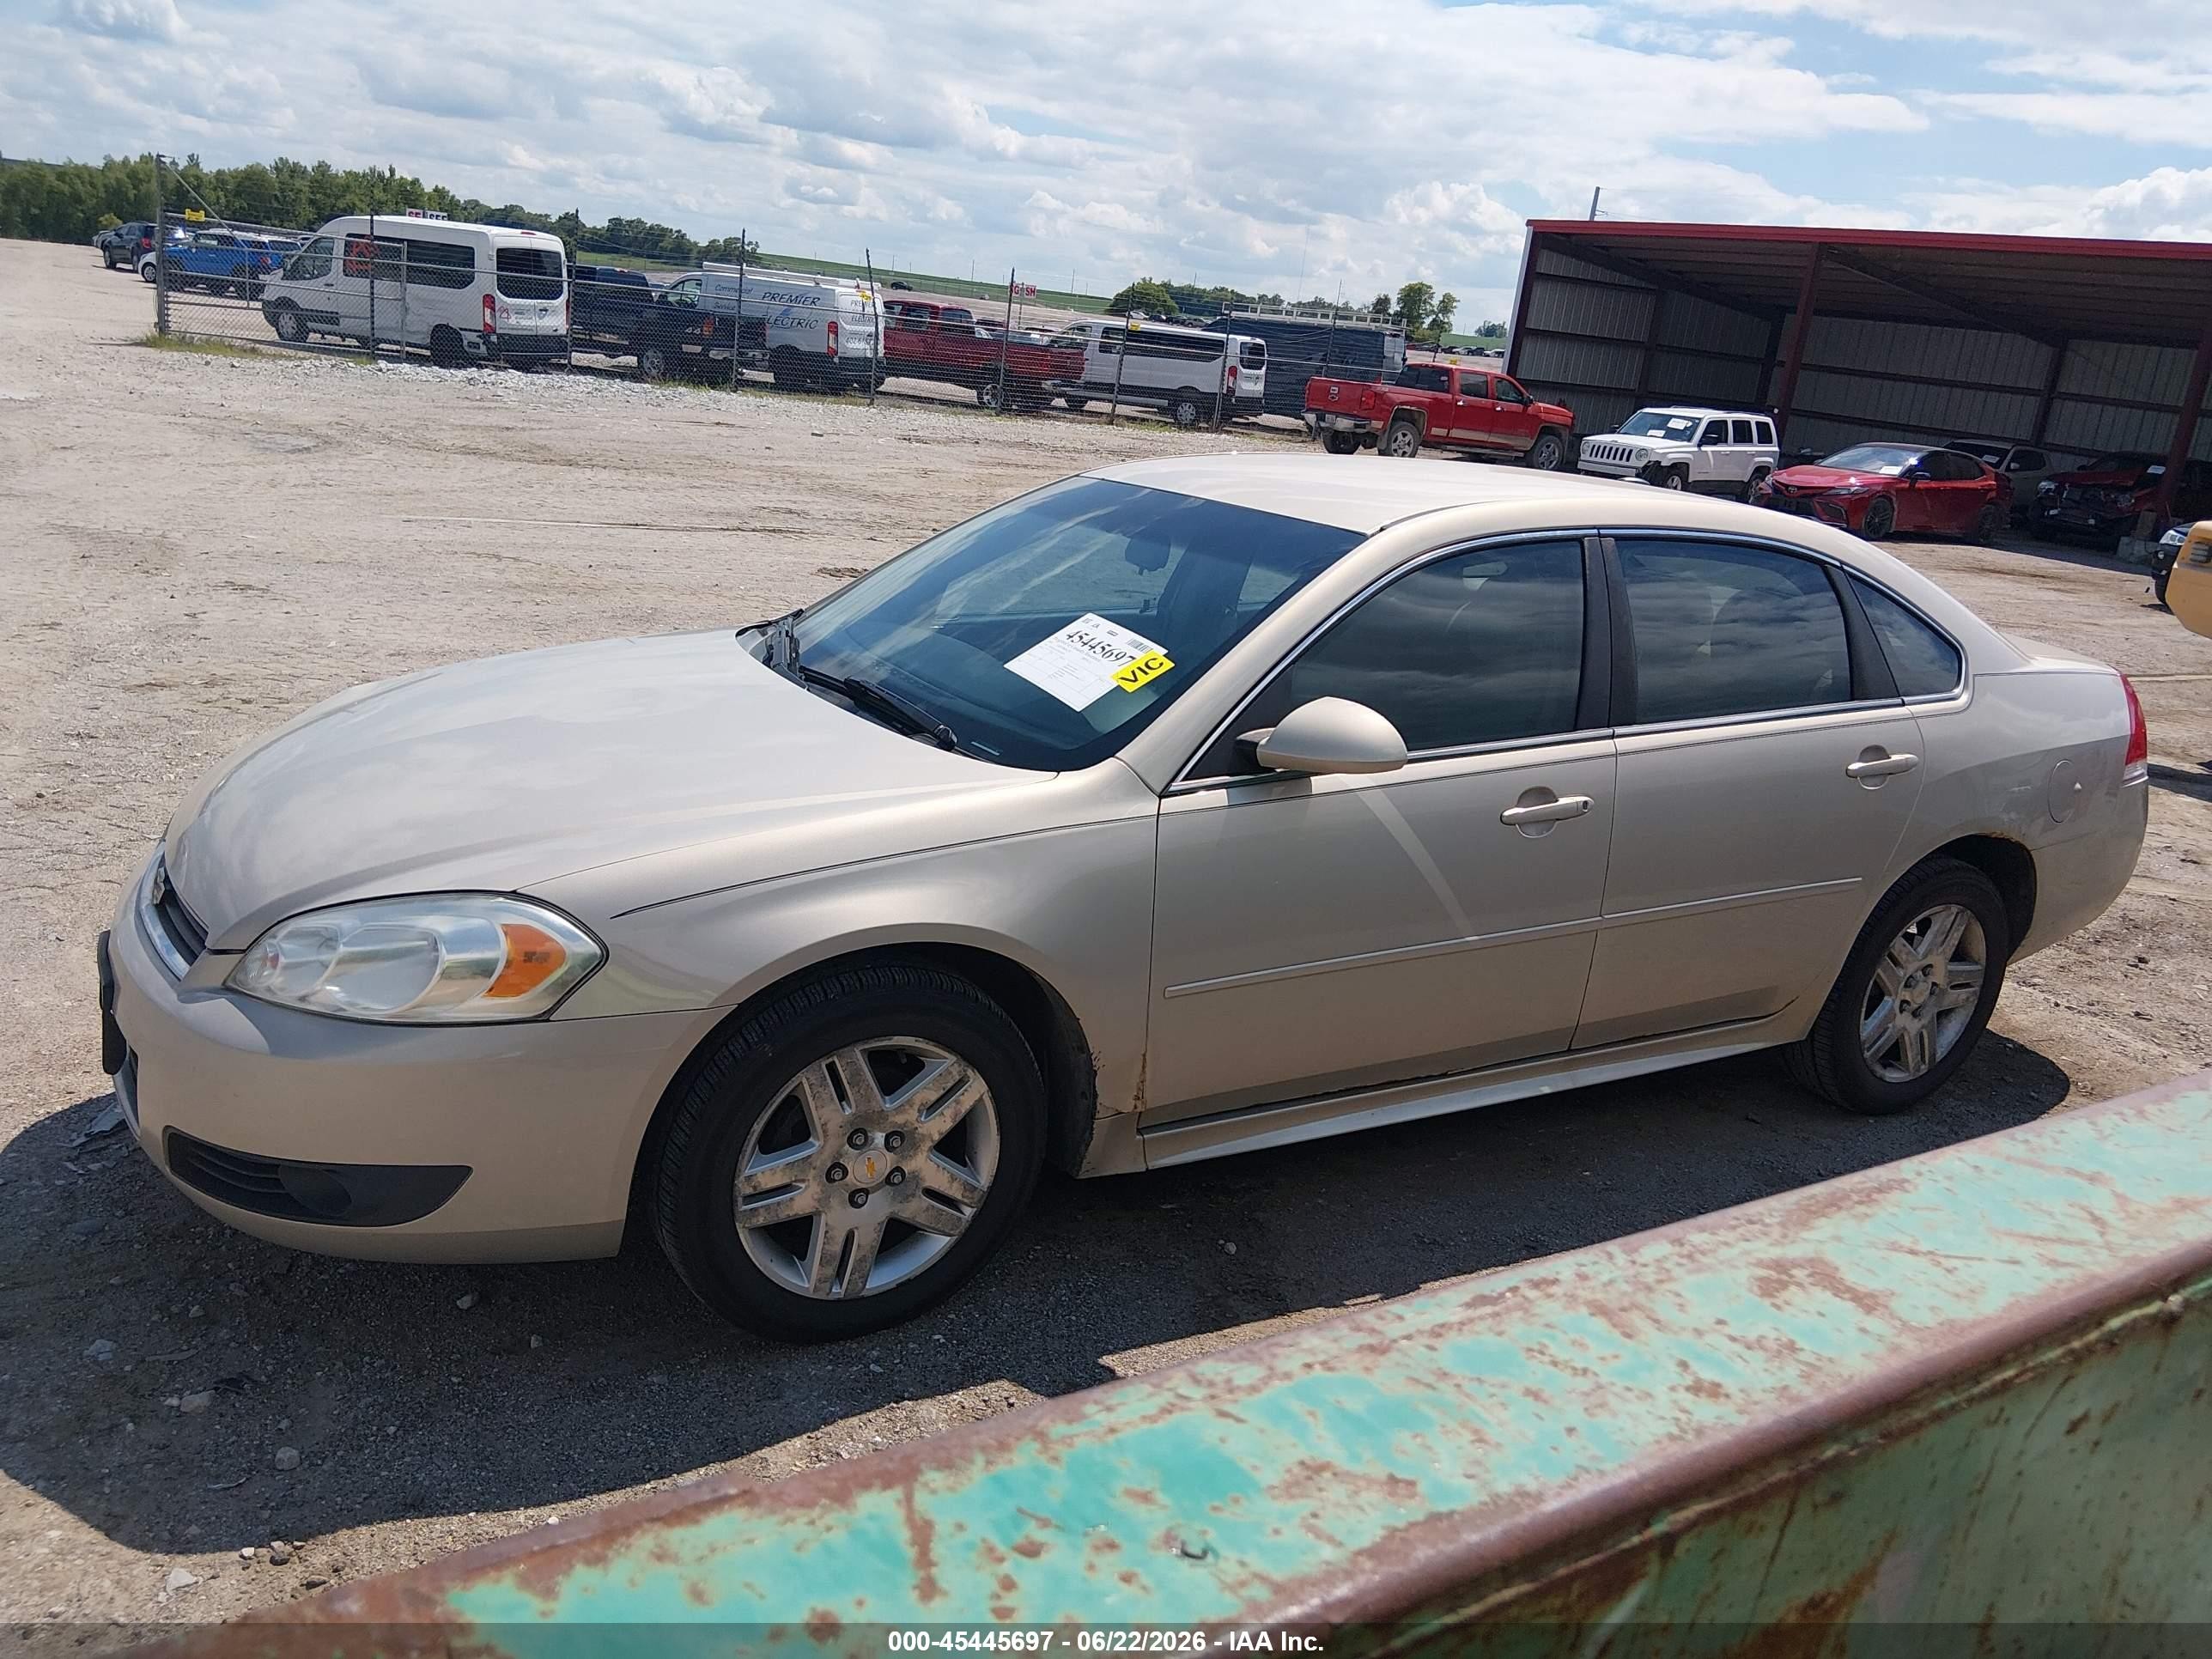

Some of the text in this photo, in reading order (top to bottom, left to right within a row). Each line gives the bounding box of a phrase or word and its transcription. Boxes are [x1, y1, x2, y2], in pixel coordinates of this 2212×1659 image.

[714, 284, 753, 295] Commecial
[714, 301, 736, 311] Service
[762, 291, 821, 307] PREMIER
[762, 314, 818, 329] LECTRIC
[1066, 630, 1138, 666] 45445697
[1119, 657, 1164, 684] VIC
